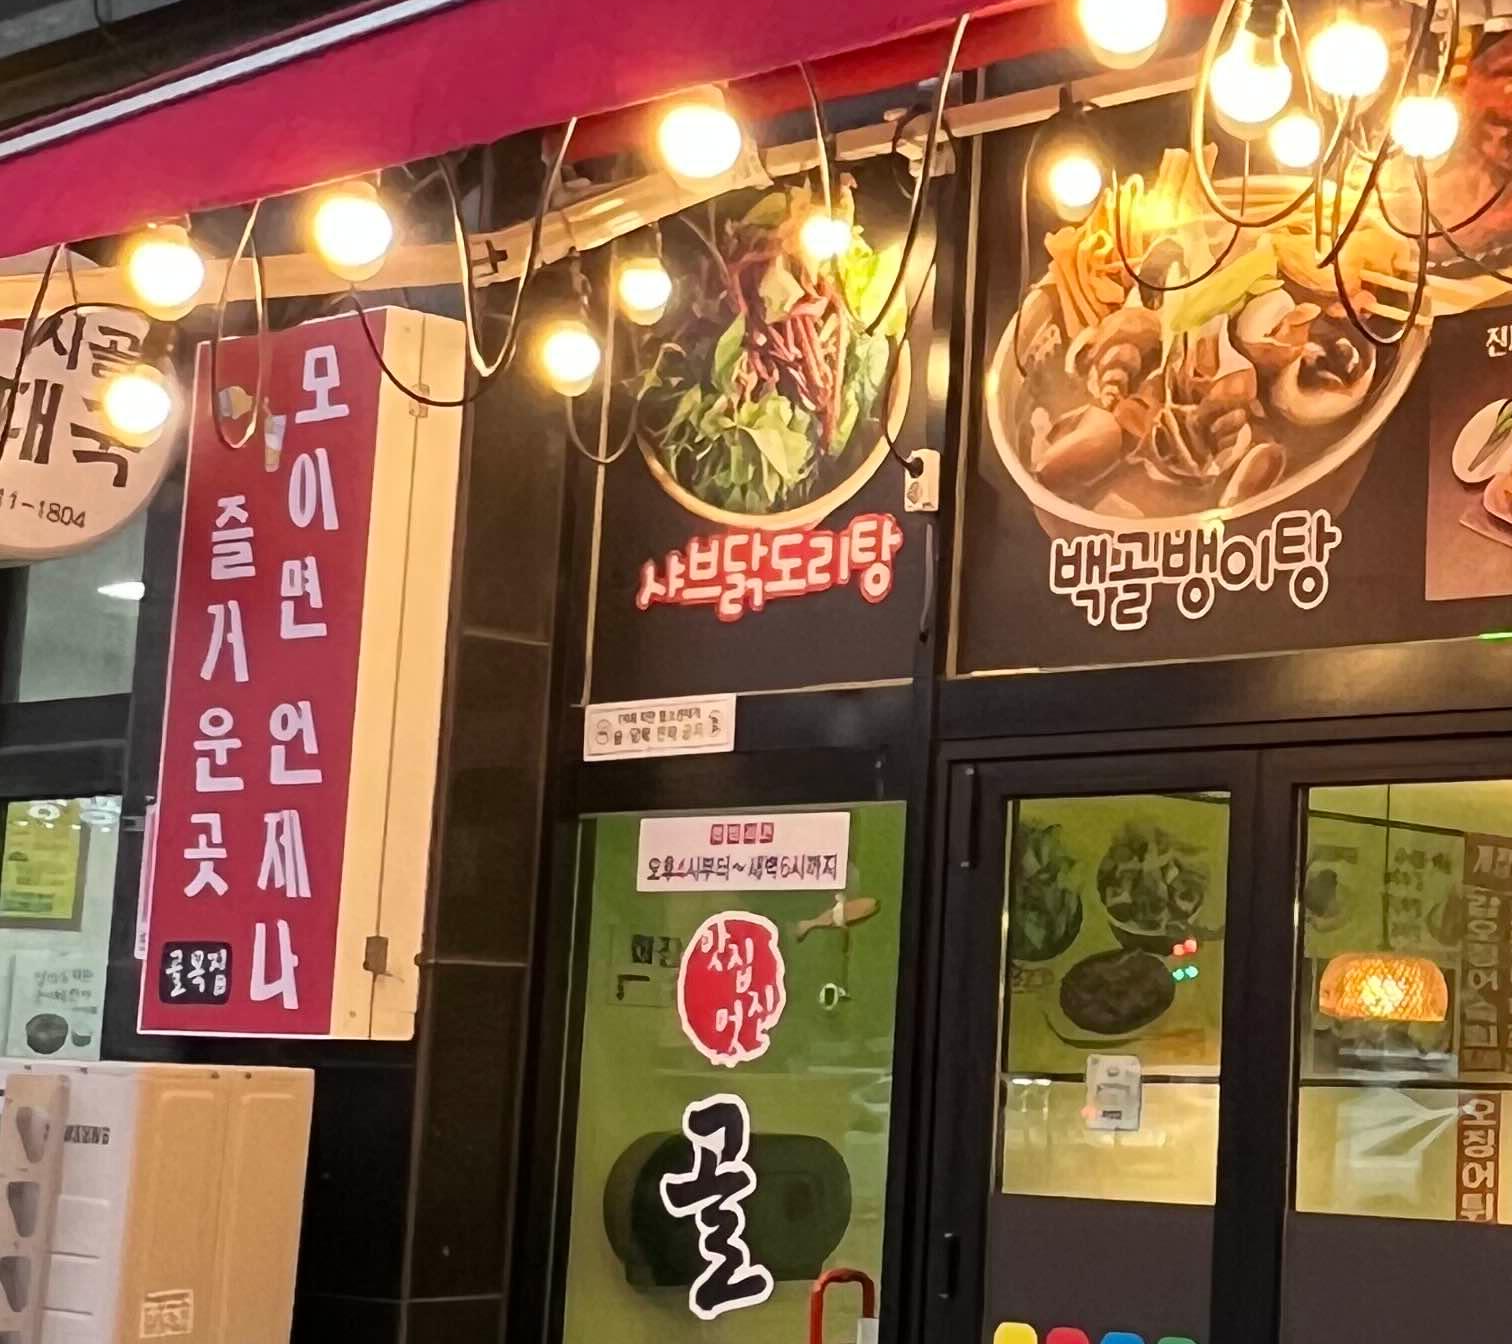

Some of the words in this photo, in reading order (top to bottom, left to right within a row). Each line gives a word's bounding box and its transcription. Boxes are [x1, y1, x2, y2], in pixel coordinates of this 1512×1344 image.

[279, 344, 351, 640] 모이면
[639, 516, 902, 619] 샤브닭도리탕
[1048, 509, 1342, 631] 백골뱅이탕
[250, 699, 323, 1010] 언제나
[165, 949, 228, 998] 골목집
[700, 923, 754, 994] 맛집
